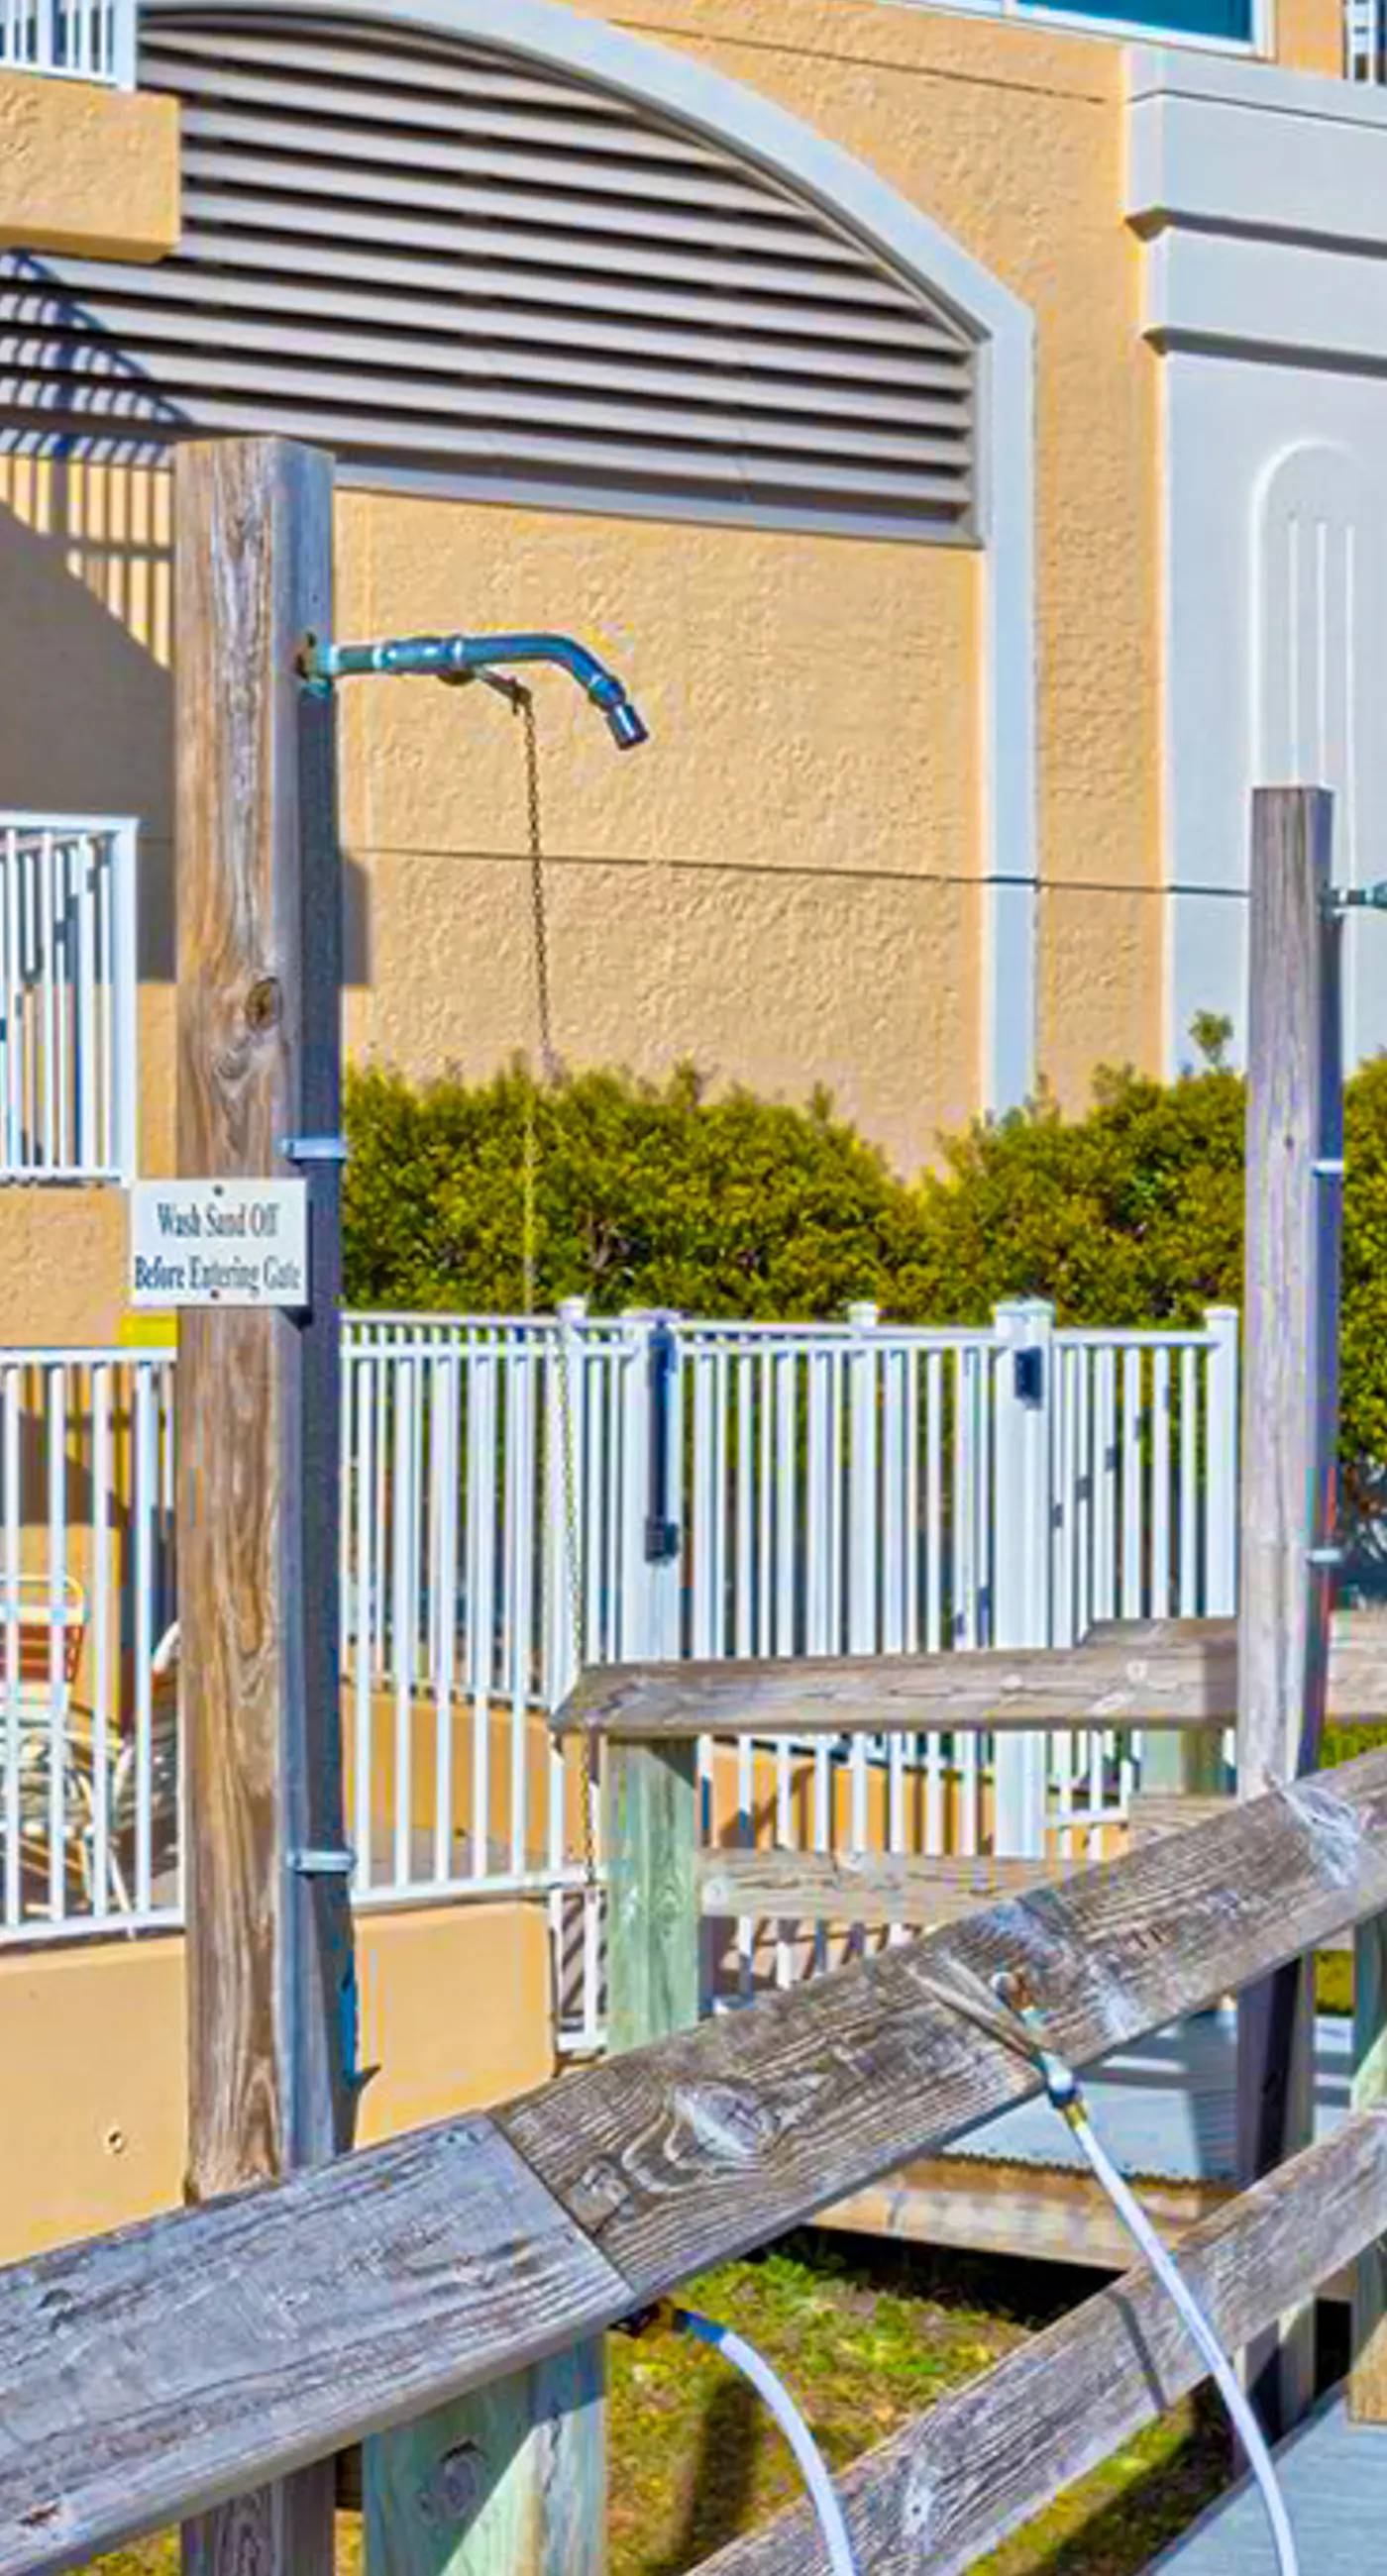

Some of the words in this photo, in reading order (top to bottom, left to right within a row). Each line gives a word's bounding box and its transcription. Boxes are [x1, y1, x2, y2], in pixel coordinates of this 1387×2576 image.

[157, 1202, 201, 1237] Wash
[206, 1201, 246, 1237] Sand
[250, 1202, 280, 1237] Off
[135, 1255, 185, 1289] Before
[188, 1255, 260, 1298] Entering
[263, 1255, 301, 1289] Gate
